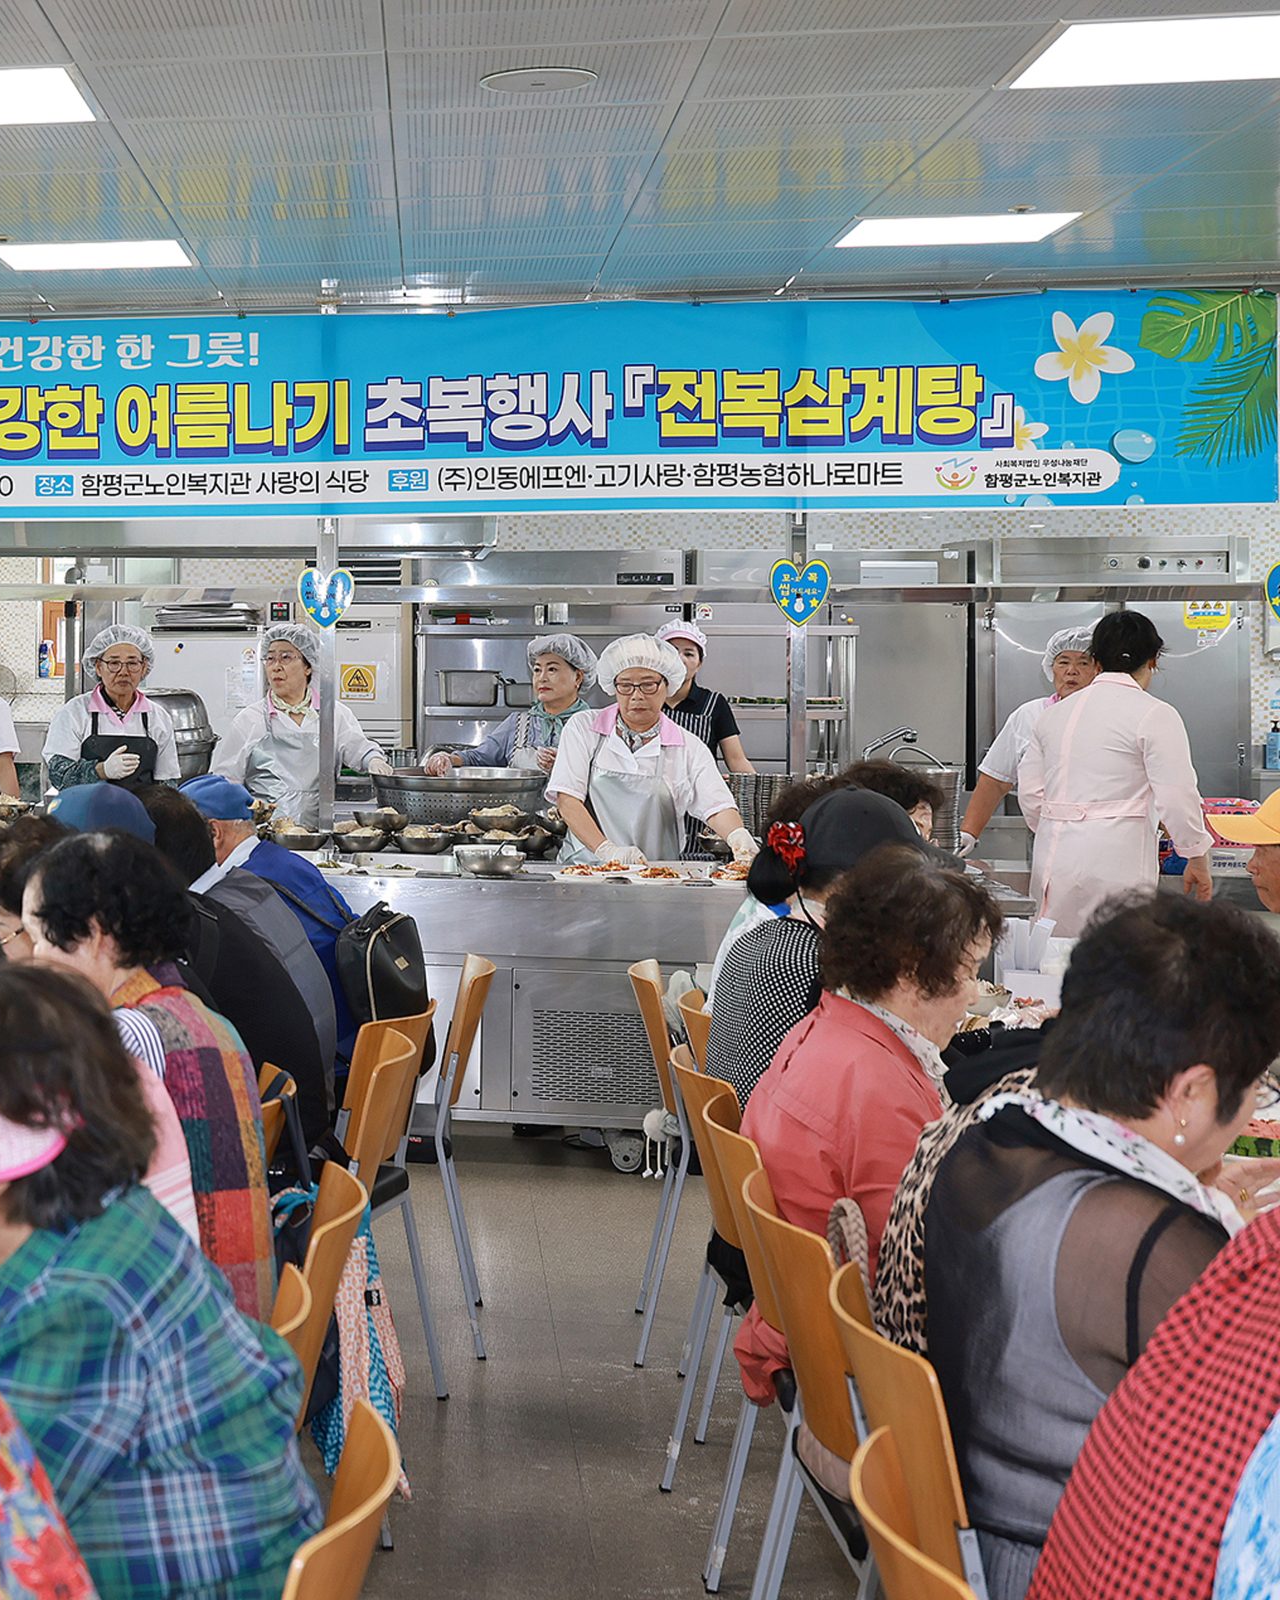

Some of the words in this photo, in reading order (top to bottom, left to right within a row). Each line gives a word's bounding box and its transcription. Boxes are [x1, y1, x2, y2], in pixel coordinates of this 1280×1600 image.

[116, 334, 155, 370] 한
[169, 331, 260, 370] 그릇!
[115, 379, 353, 456] 여름나기
[364, 369, 614, 453] 초복행사
[995, 459, 1040, 468] 사회복지법인
[38, 477, 72, 494] 장소
[81, 473, 251, 496] 함평군노인복지관
[256, 471, 320, 495] 사랑의
[325, 470, 369, 494] 식당
[391, 471, 426, 488] 후원
[984, 472, 1102, 488] 함평군노인복지관
